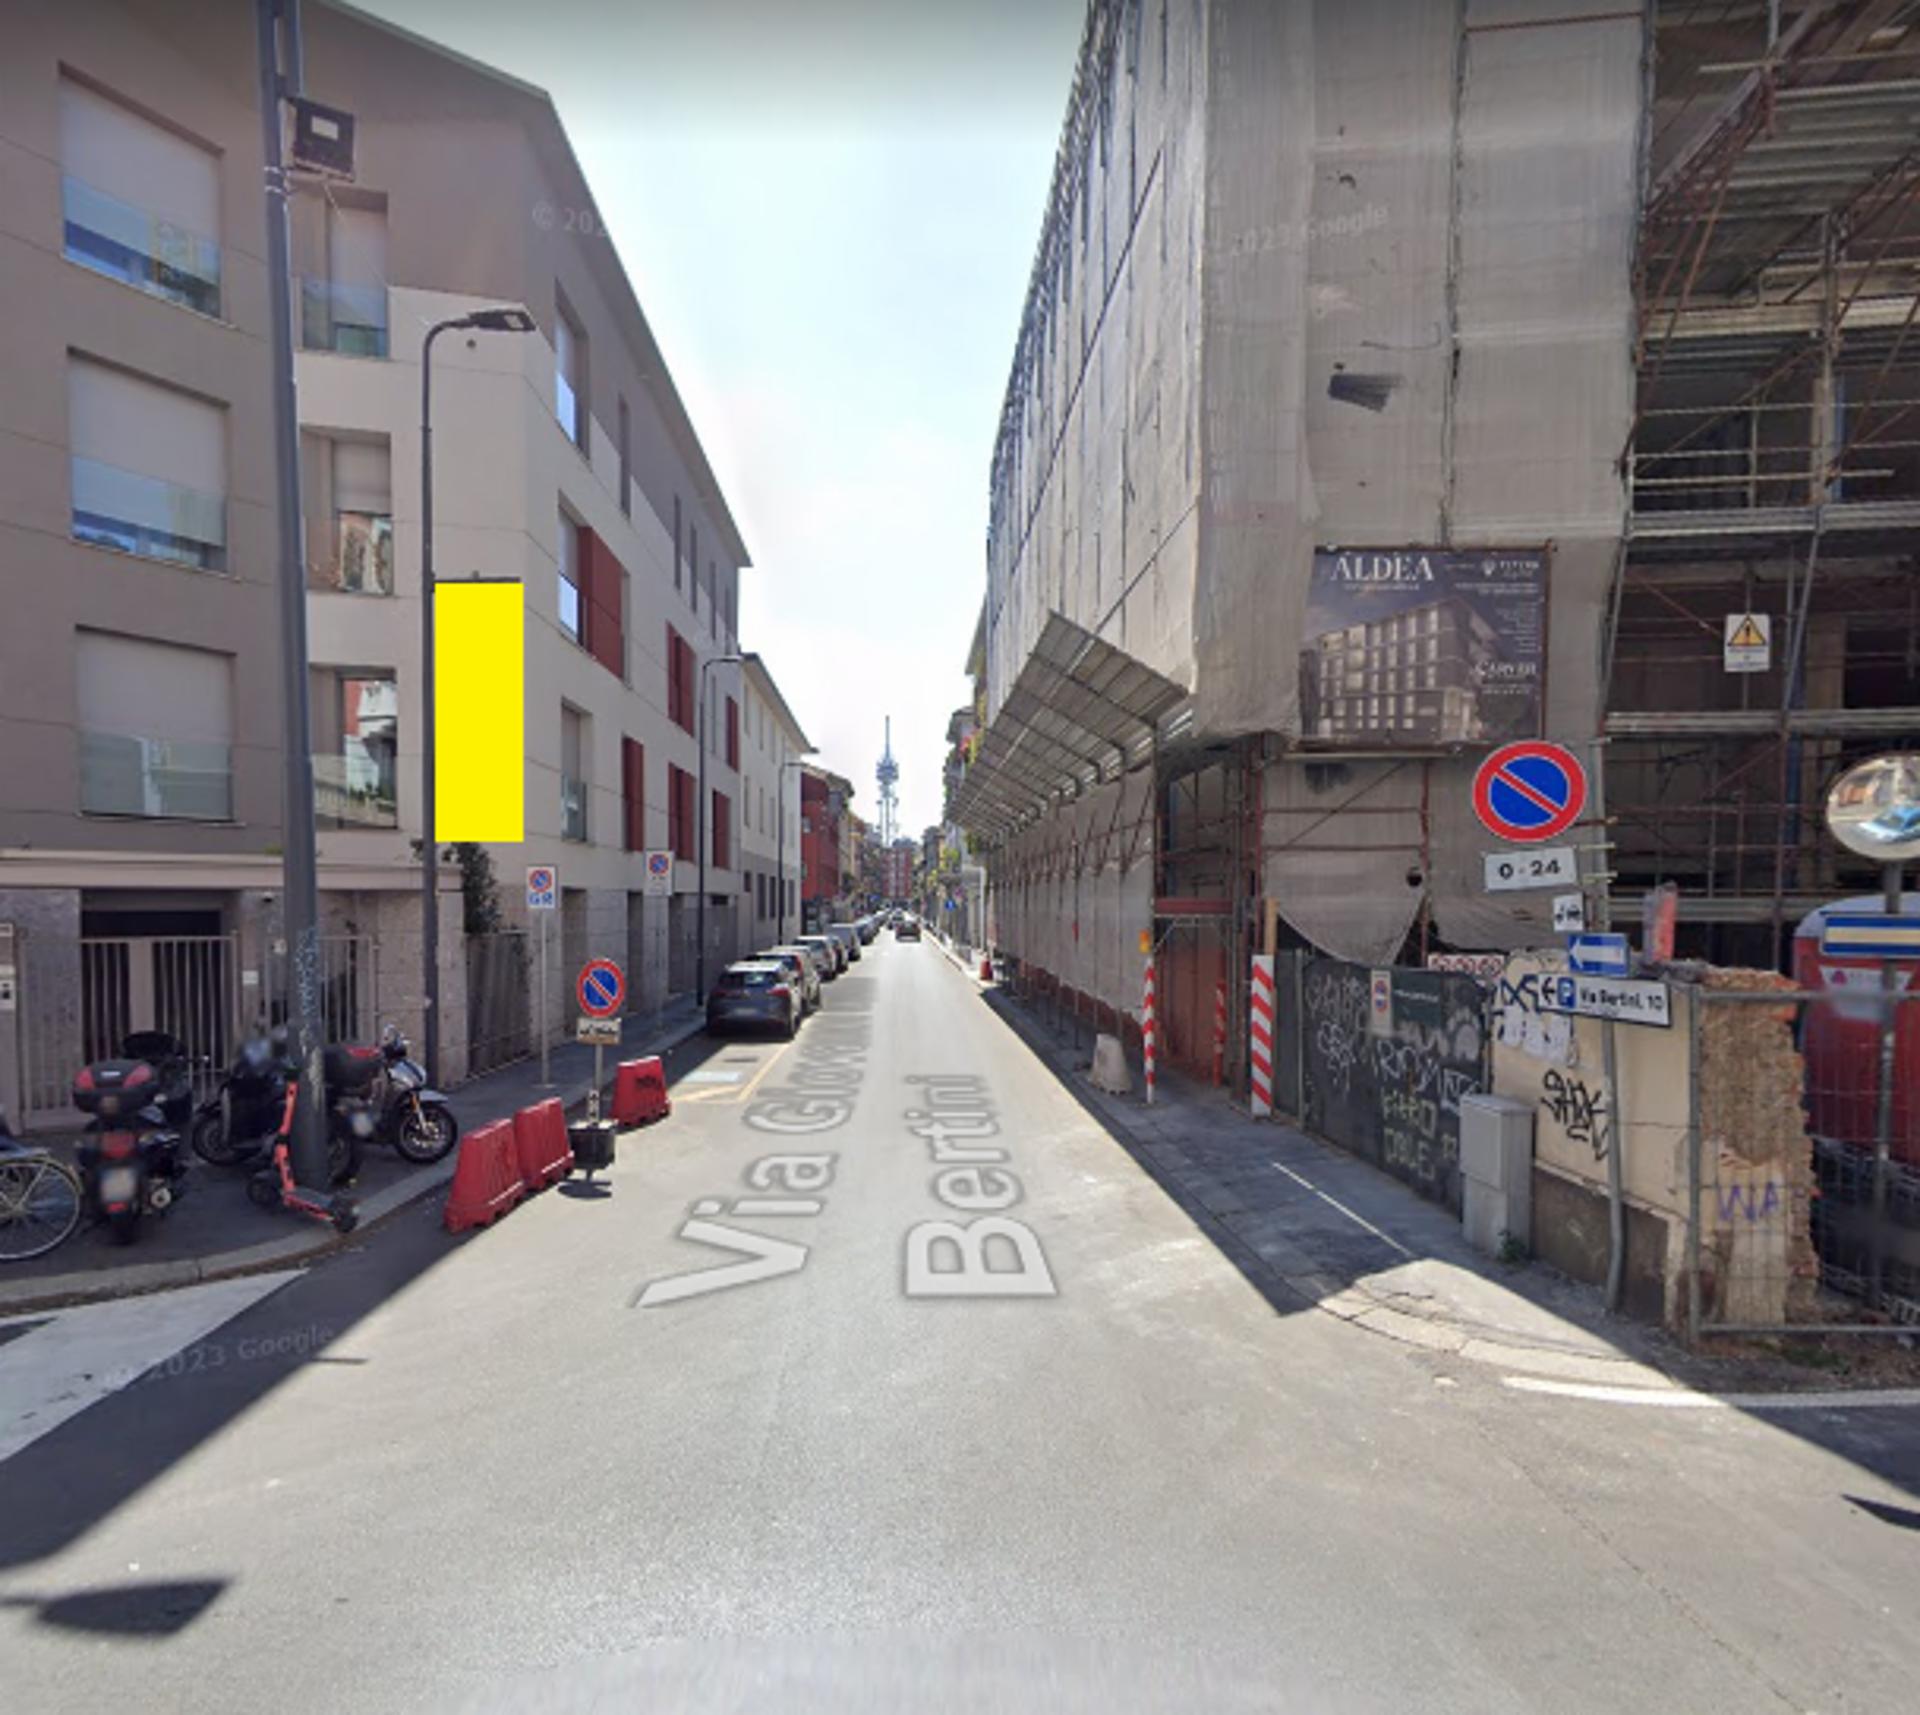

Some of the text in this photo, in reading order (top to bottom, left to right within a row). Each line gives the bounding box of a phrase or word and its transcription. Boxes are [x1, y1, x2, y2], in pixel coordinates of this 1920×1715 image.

[1330, 555, 1435, 582] ALDEA
[1498, 863, 1513, 880] 0
[1529, 858, 1561, 877] 24
[1646, 994, 1663, 1012] 10
